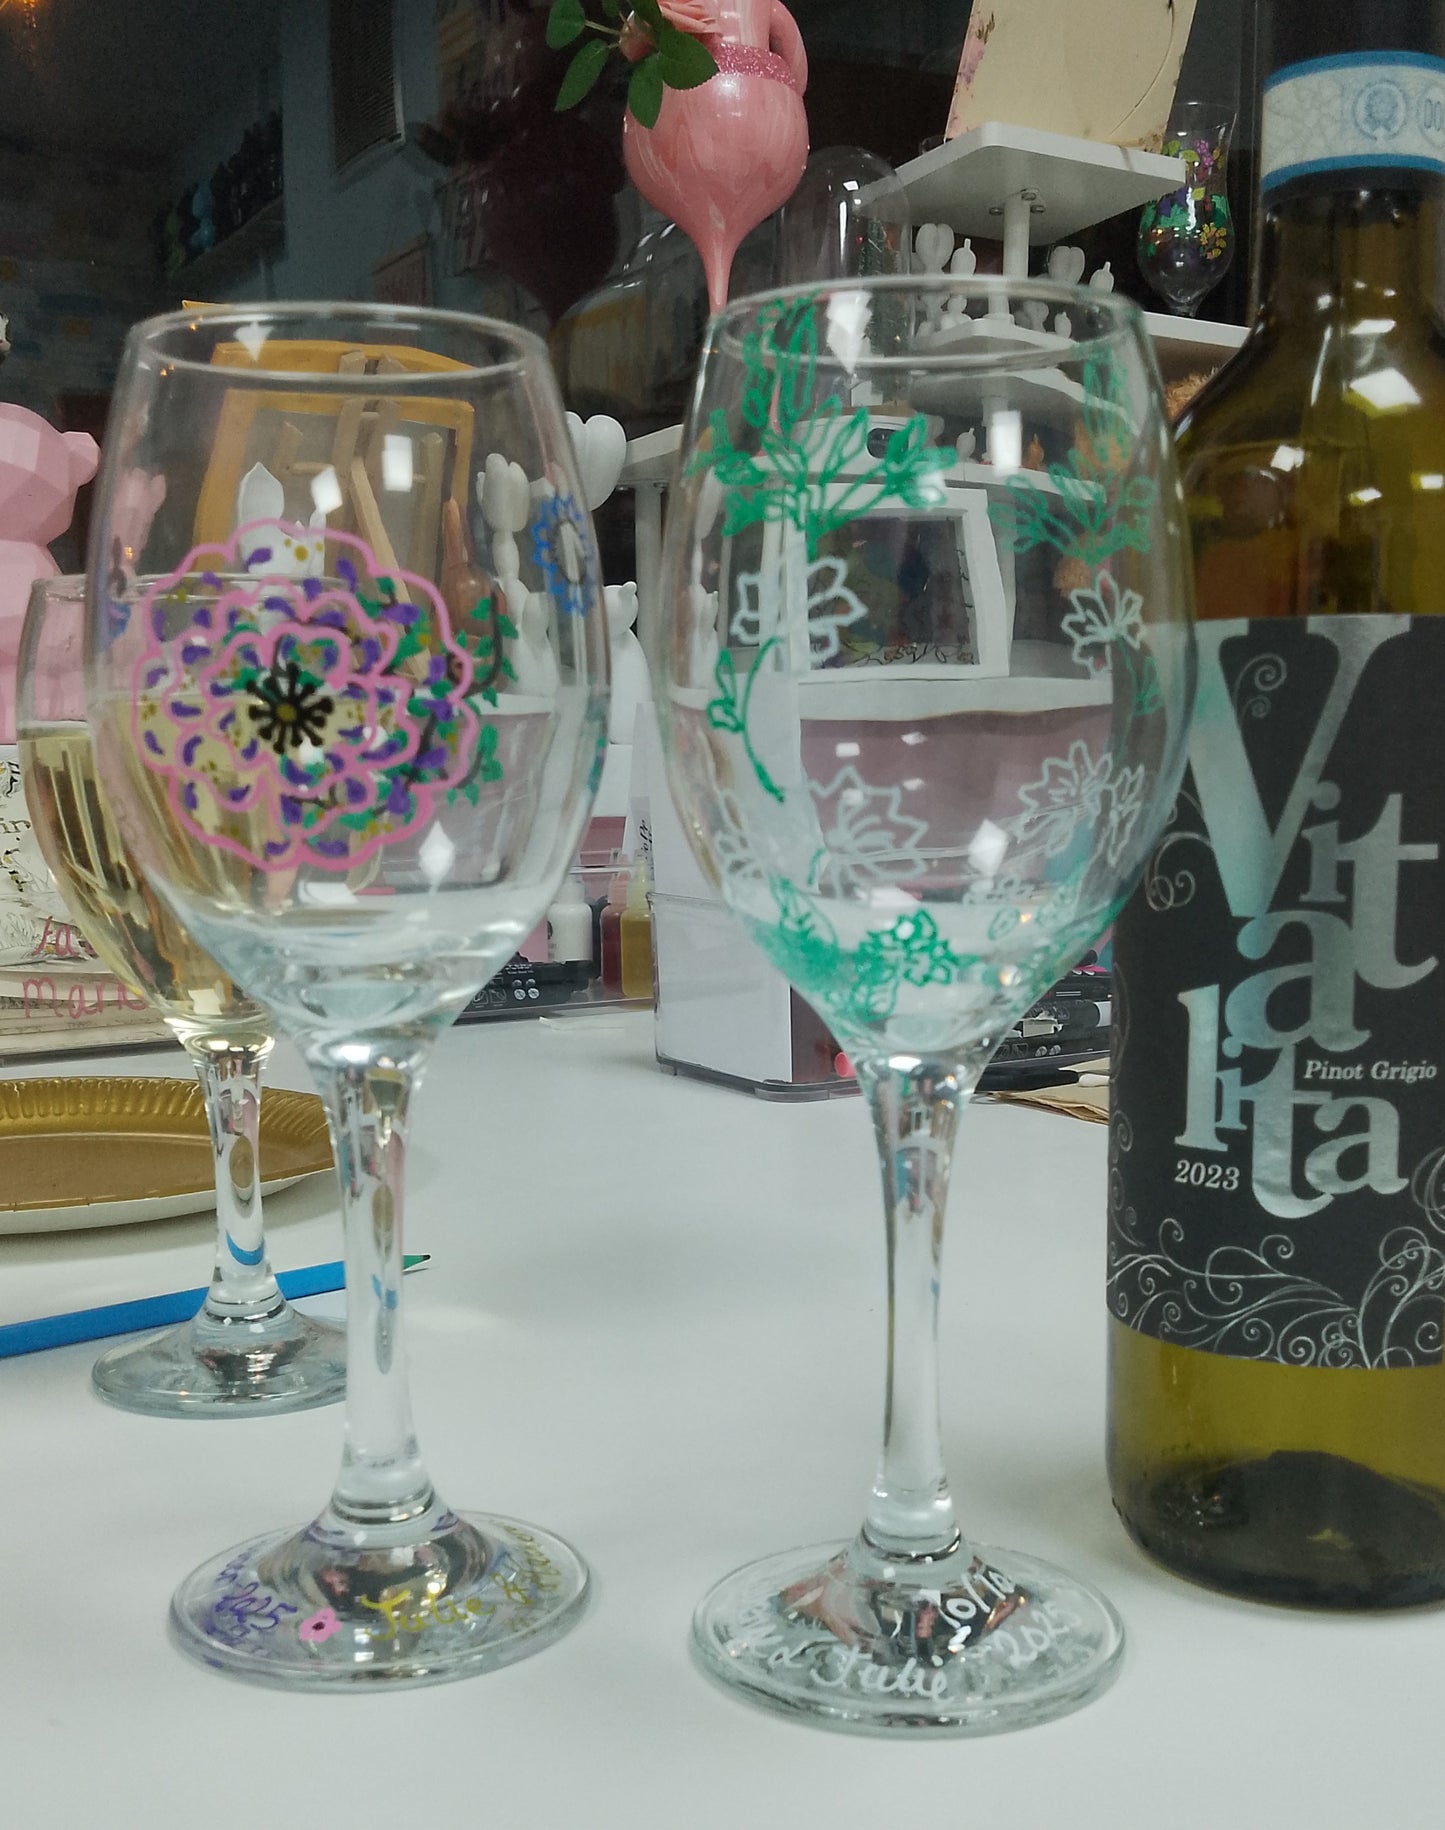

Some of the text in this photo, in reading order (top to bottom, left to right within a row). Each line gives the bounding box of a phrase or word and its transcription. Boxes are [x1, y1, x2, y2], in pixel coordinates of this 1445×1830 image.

[1303, 1060, 1437, 1083] Pinot Grigio
[1174, 1160, 1240, 1191] 2023
[810, 1646, 955, 1705] Julie
